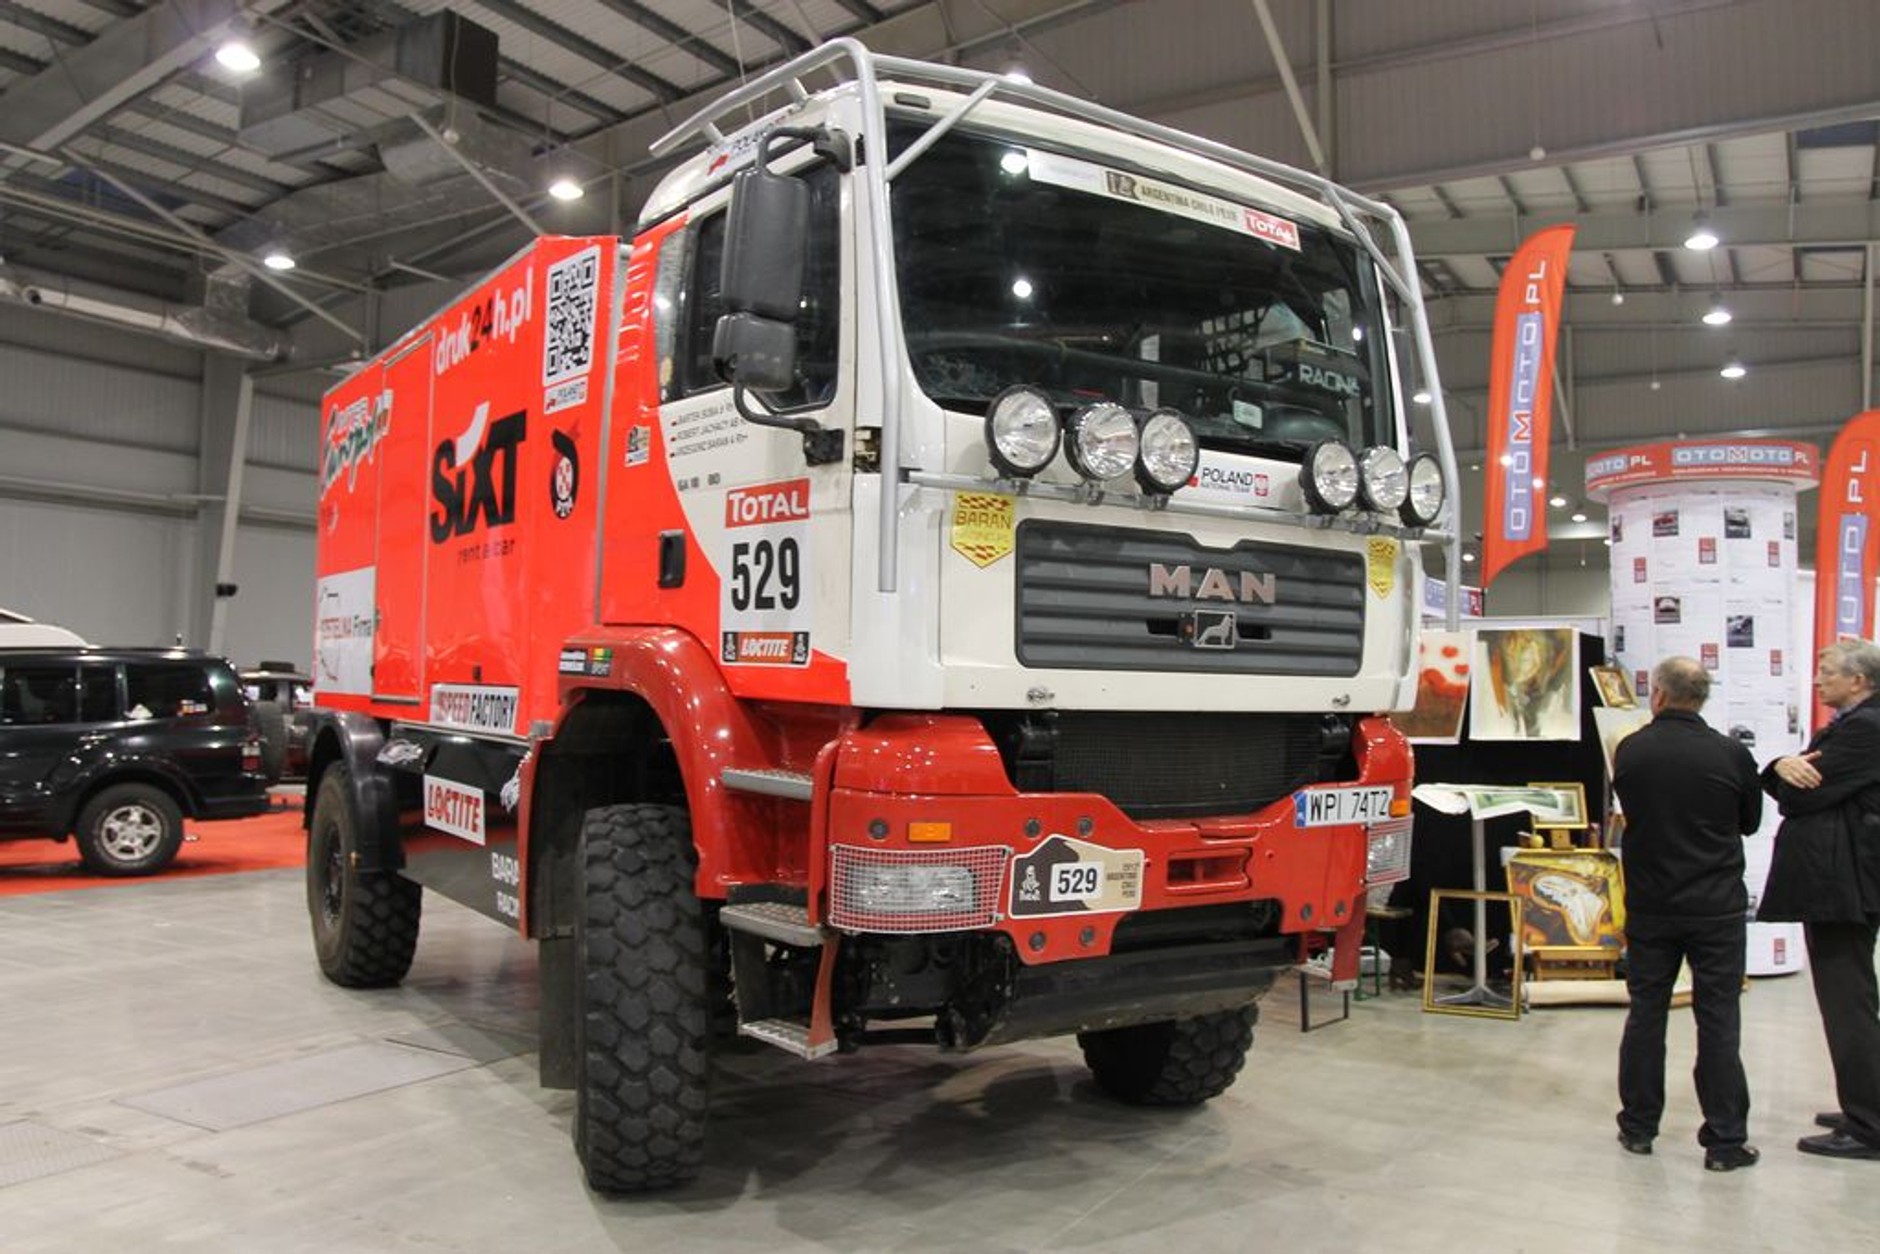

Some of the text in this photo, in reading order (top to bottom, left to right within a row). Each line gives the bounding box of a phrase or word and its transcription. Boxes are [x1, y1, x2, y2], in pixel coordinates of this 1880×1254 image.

[435, 266, 533, 376] druk24h.pl
[1676, 445, 1792, 463] OTOMOTO
[1201, 467, 1254, 486] POLAND
[728, 491, 806, 522] TOTAL
[955, 509, 1012, 530] BARAN
[731, 537, 800, 611] 529
[1149, 563, 1276, 604] MAN
[740, 638, 789, 657] LOCTITE
[428, 784, 480, 833] LOCTITE
[1310, 790, 1389, 822] WPI 74T2
[1057, 867, 1098, 895] 529
